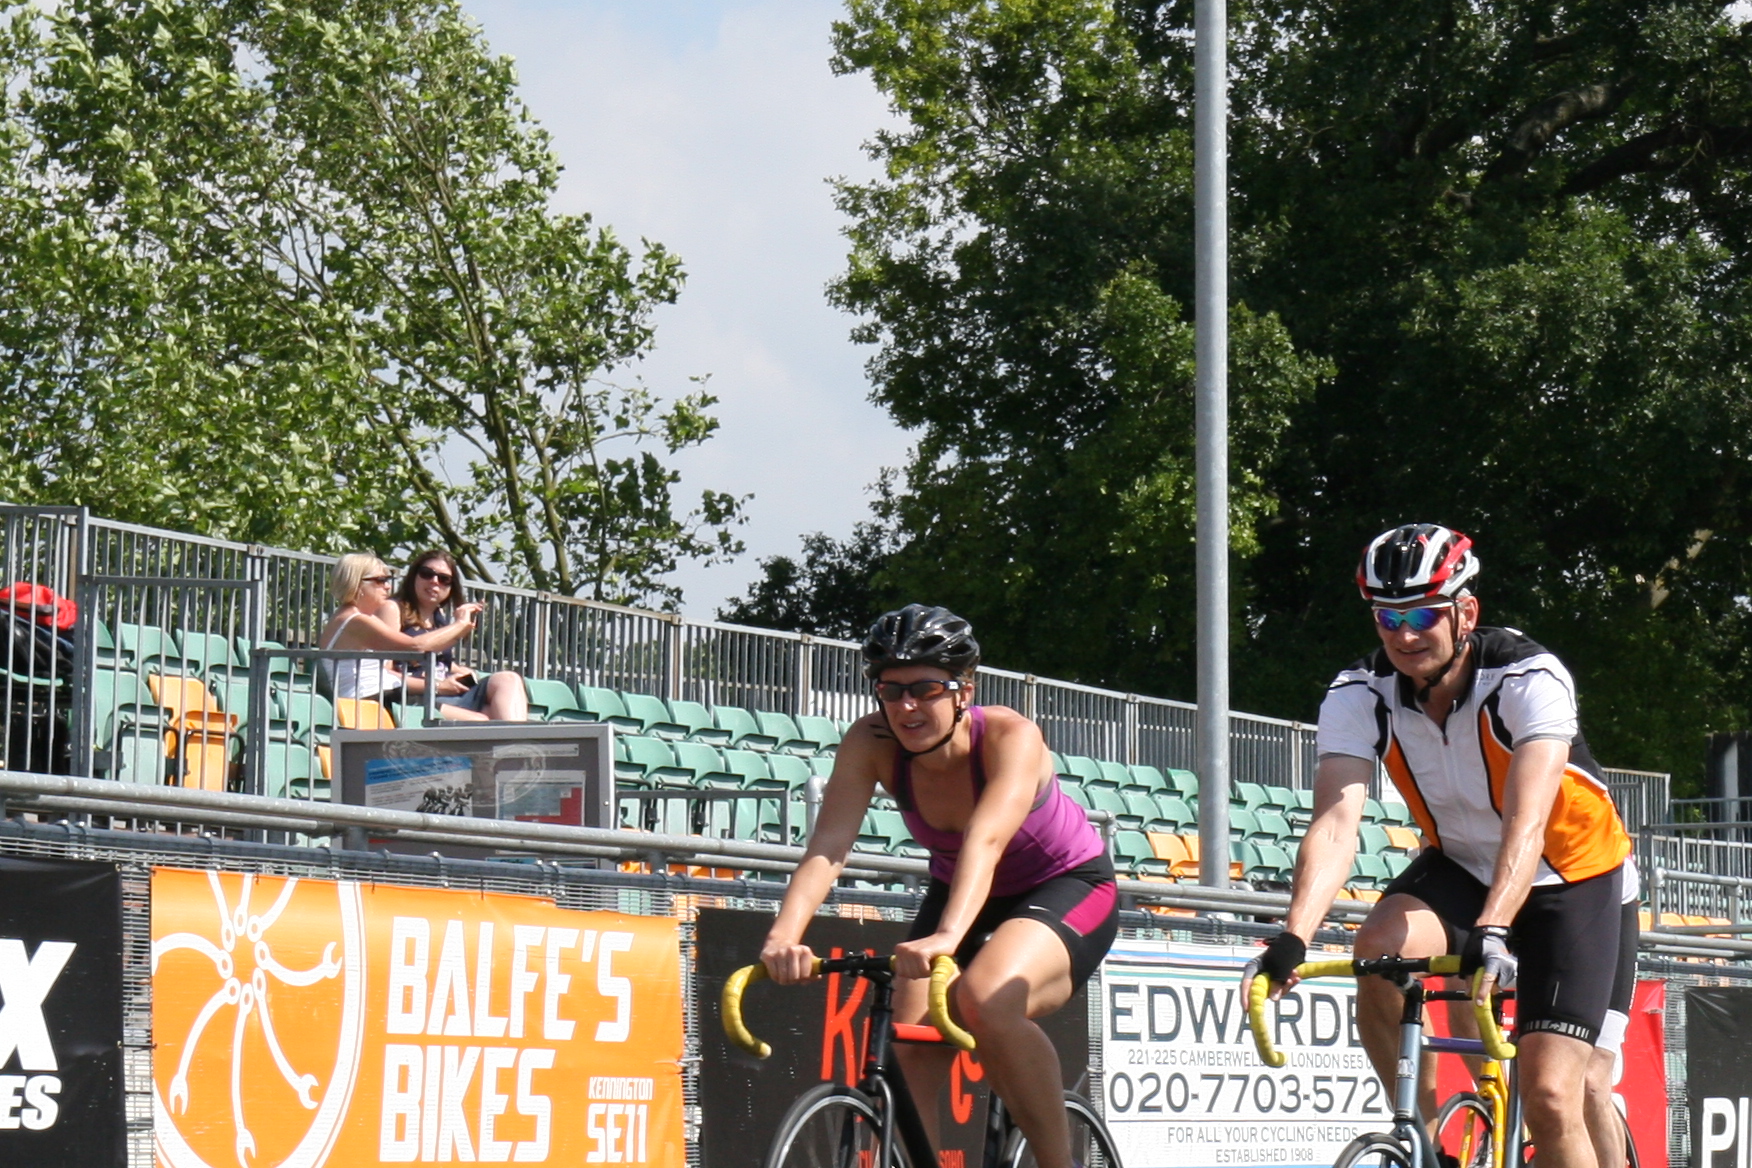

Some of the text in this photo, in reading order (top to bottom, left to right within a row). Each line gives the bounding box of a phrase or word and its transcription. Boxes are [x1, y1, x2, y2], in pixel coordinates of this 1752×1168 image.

[387, 916, 635, 1042] BALFE'S
[1128, 1050, 1177, 1066] 221-225
[1291, 1053, 1340, 1069] LONDON
[1343, 1054, 1364, 1070] SE5
[588, 1076, 654, 1101] KENNINGTON
[379, 1044, 556, 1163] BIKES
[586, 1103, 648, 1163] SE11
[1167, 1127, 1359, 1143] FOR ALL YOUR CYCLING NEEDS
[1215, 1148, 1314, 1163] ESTABLISHED 1908
